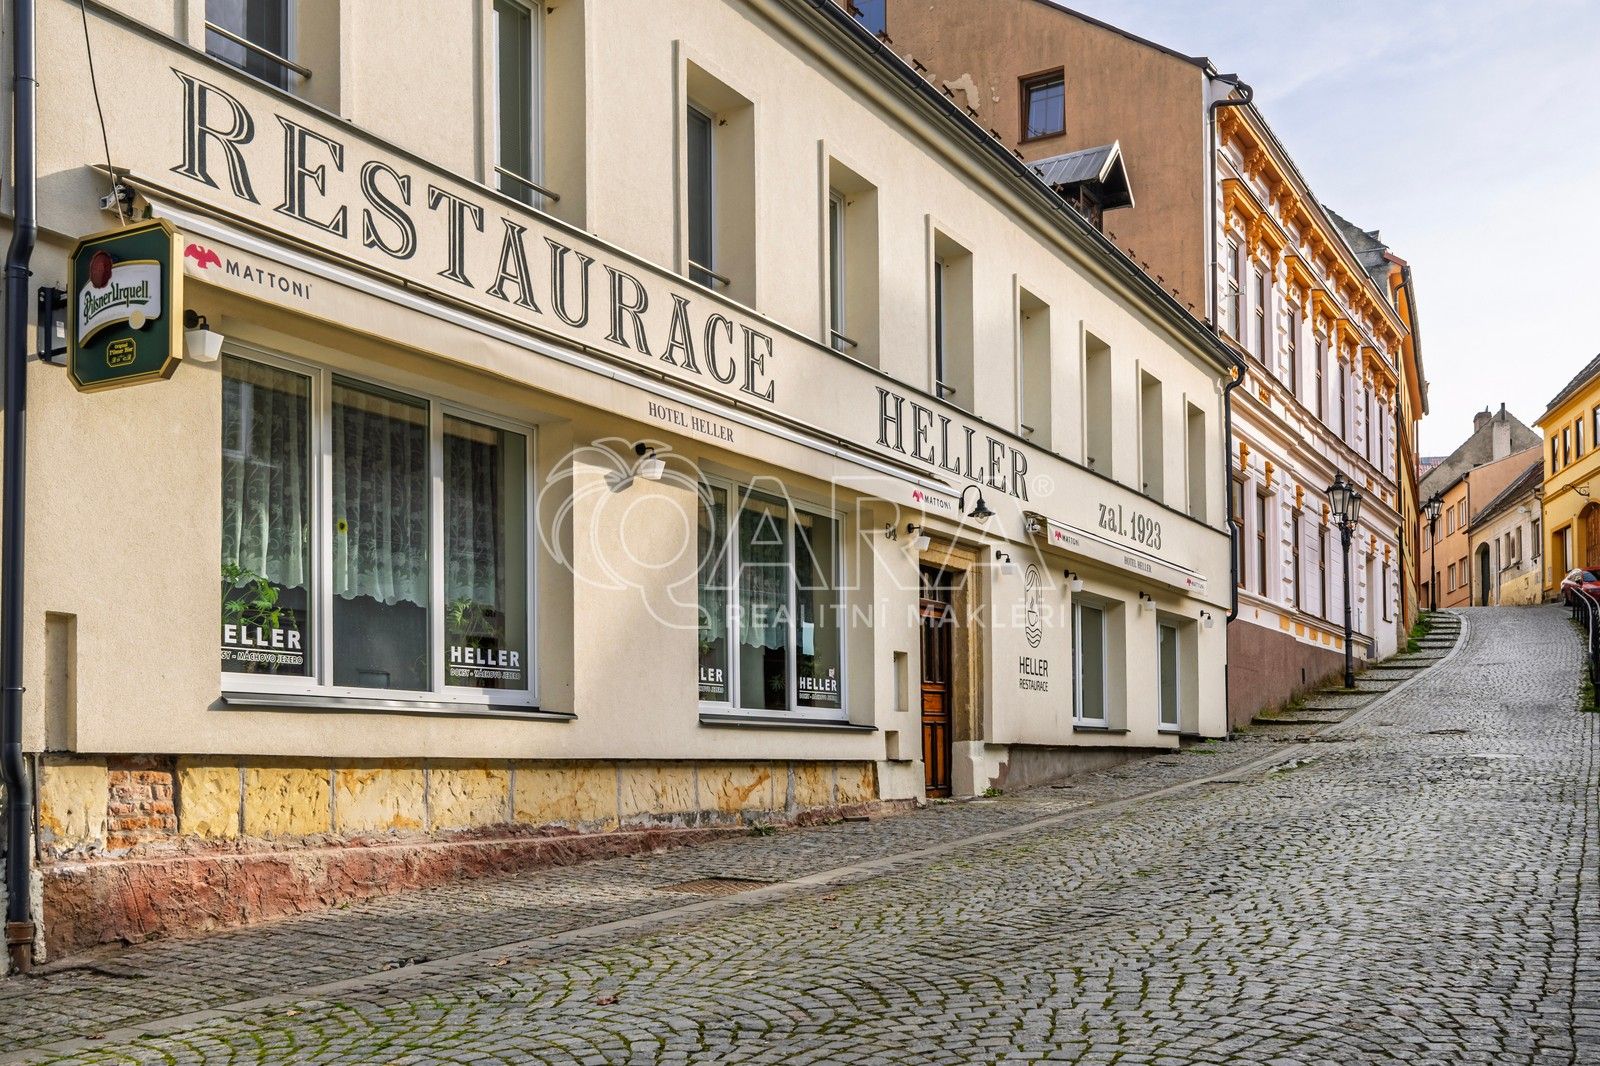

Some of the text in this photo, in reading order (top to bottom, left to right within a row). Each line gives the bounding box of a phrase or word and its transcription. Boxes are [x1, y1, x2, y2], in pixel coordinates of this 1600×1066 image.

[170, 66, 775, 403] RESTAURACE
[226, 259, 310, 299] MATTONI
[84, 280, 149, 326] Pilsner Urquell
[648, 401, 735, 443] HOTEL HELLER
[875, 386, 1029, 502] HELLER
[924, 494, 952, 510] MATTONI
[1098, 503, 1162, 551] zal. 1923
[237, 650, 276, 663] MÁCHOVO
[276, 654, 304, 665] JEZERO
[450, 645, 520, 667] HELLER
[1019, 655, 1049, 678] HELLER
[799, 676, 837, 692] HELLER
[1019, 678, 1049, 692] RESTAURACE
